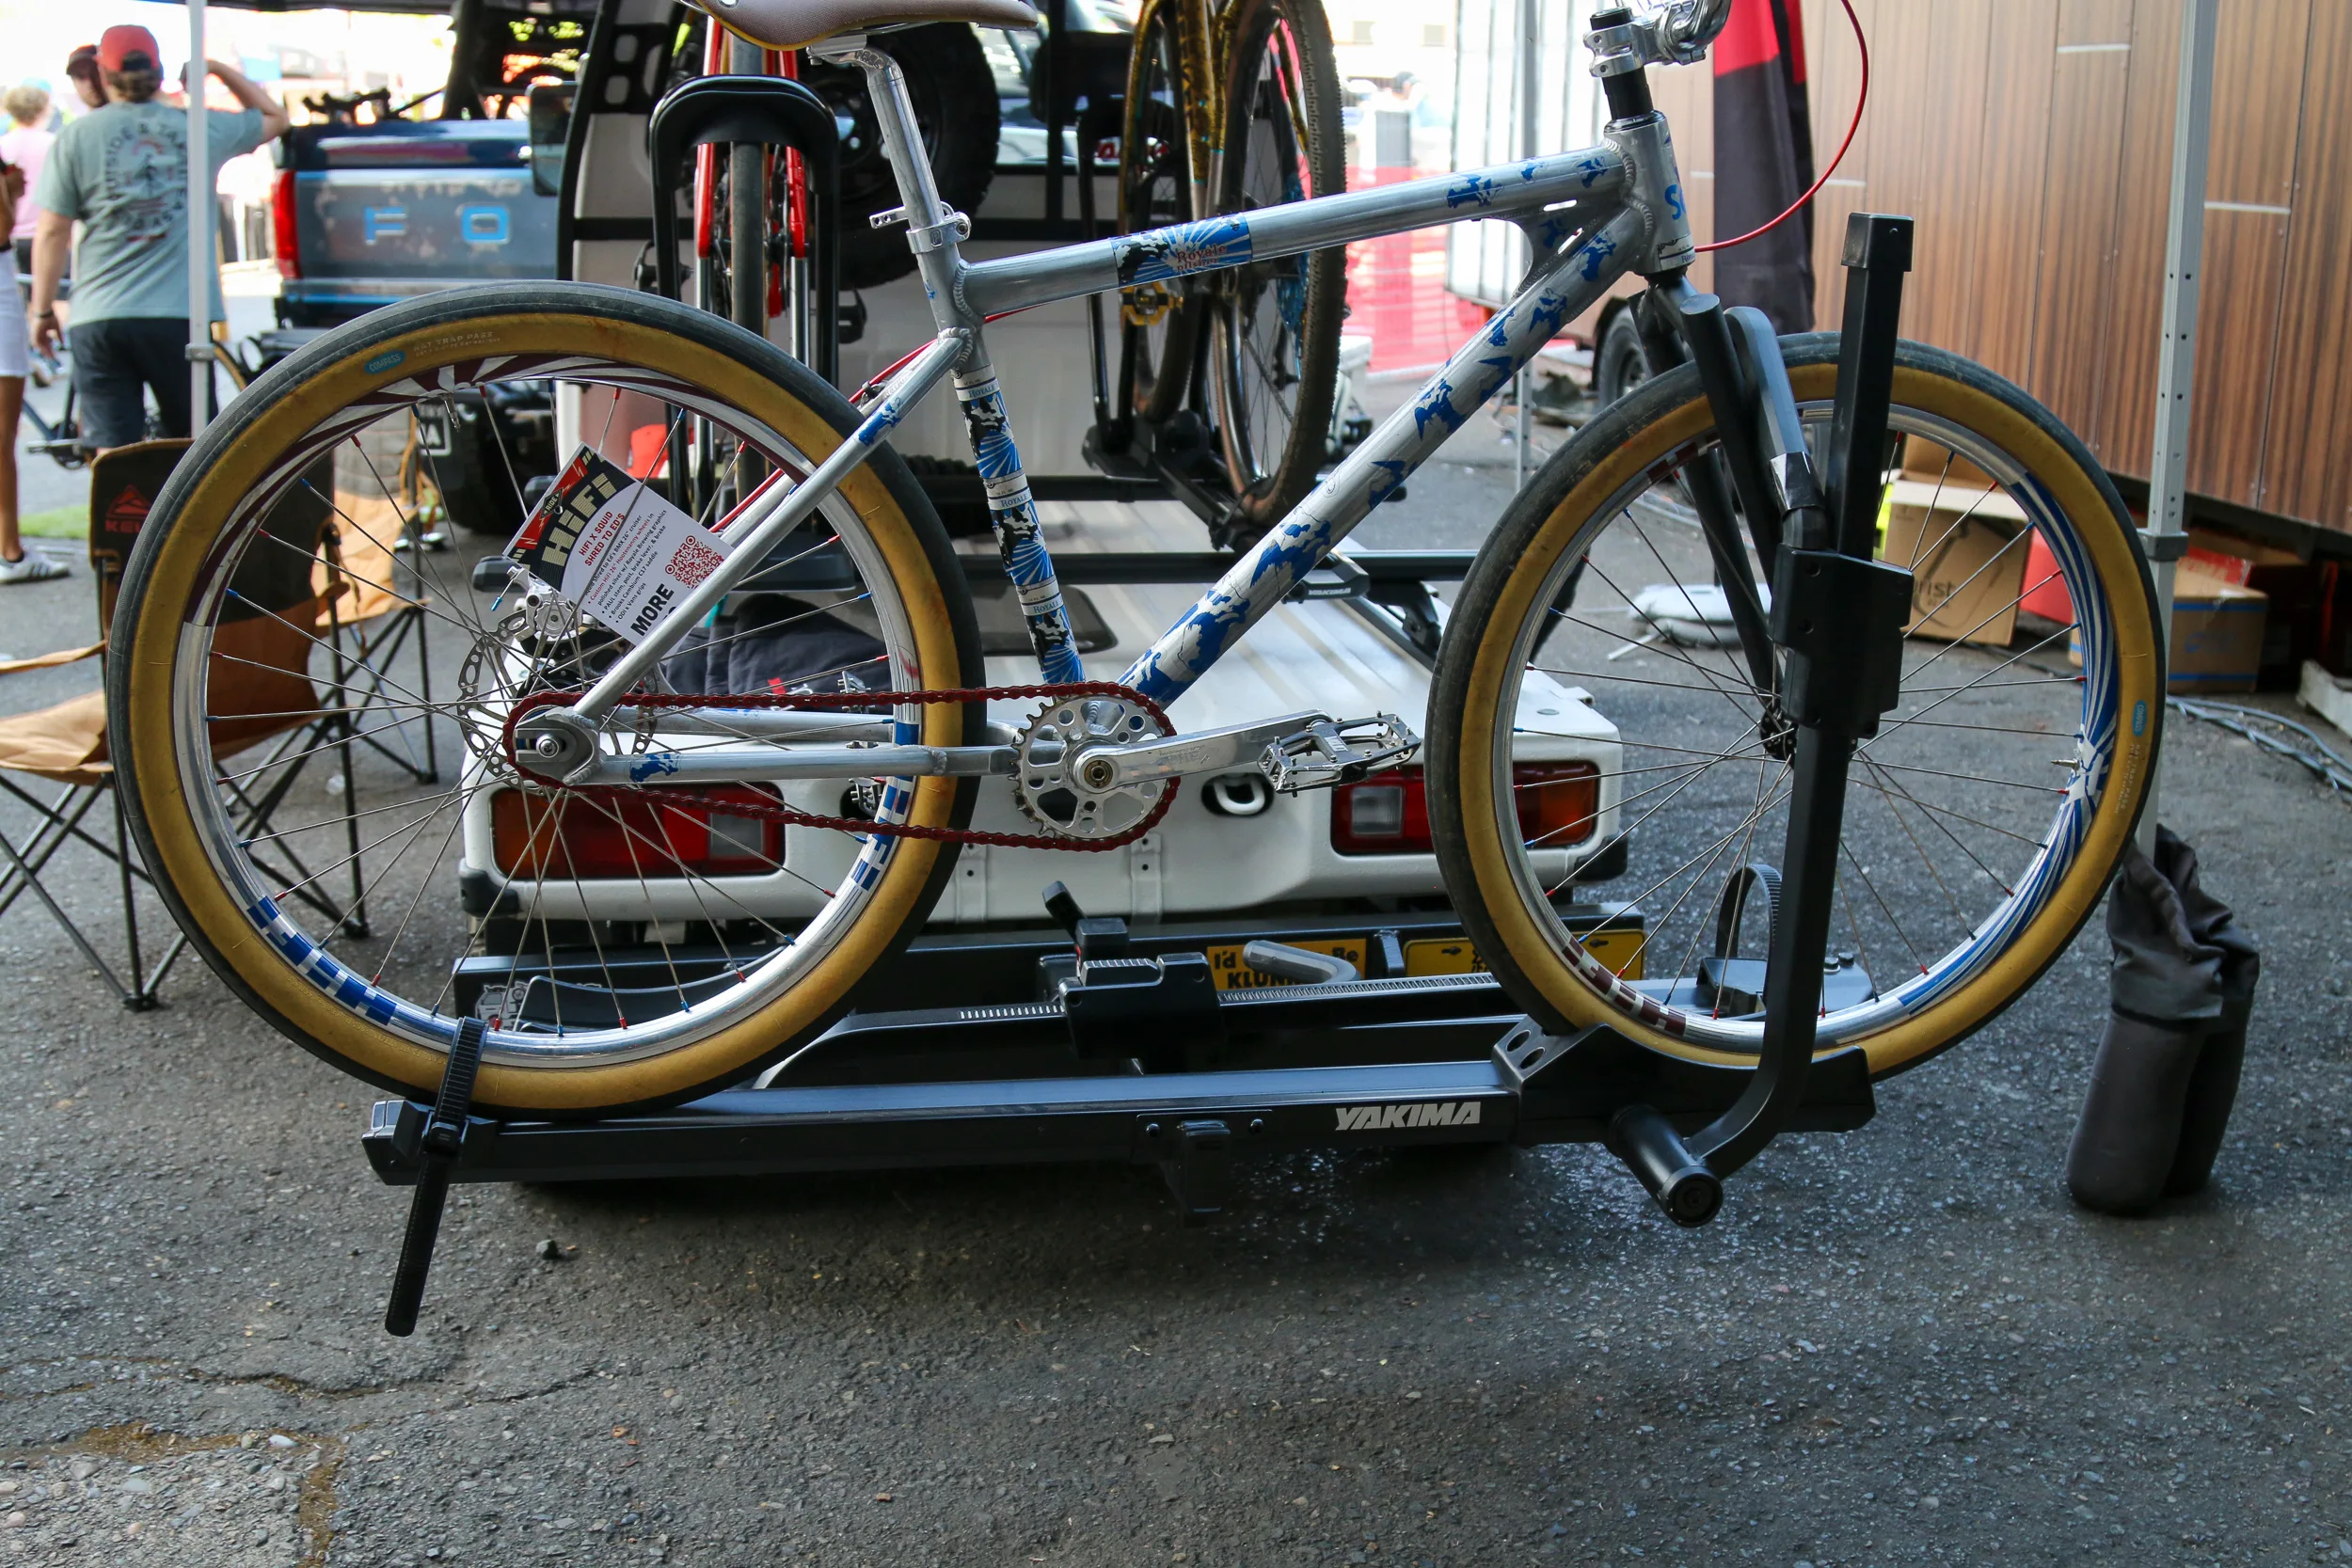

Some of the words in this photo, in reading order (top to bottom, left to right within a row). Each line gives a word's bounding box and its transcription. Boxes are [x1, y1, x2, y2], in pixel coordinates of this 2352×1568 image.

[1177, 244, 1228, 263] Royale
[369, 353, 402, 372] COMPASS
[968, 384, 996, 398] ROYALE
[545, 496, 558, 511] RIDE
[1000, 494, 1028, 508] ROYALE
[578, 540, 593, 556] HIFI
[589, 532, 597, 541] X
[594, 511, 612, 533] SQUID
[584, 541, 605, 566] SHRED
[601, 530, 612, 541] TO
[609, 513, 627, 531] ED'S
[613, 540, 625, 552] BMX
[628, 515, 642, 531] cruiser
[590, 582, 605, 600] Custom
[615, 534, 639, 564] Hootenanny
[636, 518, 650, 535] wheels
[597, 584, 613, 606] polished
[612, 572, 622, 585] silver
[625, 548, 639, 564] Royale
[636, 529, 654, 549] Brewing
[651, 510, 667, 531] graphics
[603, 596, 615, 610] PAUL
[630, 557, 643, 572] brake
[653, 525, 666, 539] brake
[610, 598, 625, 615] Brooks
[622, 576, 641, 598] Cambium
[638, 565, 646, 577] C17
[645, 550, 658, 567] saddle
[627, 594, 638, 606] Vans
[636, 582, 646, 595] grips
[629, 583, 675, 636] MORE
[1032, 600, 1059, 613] ROYALE
[2134, 704, 2145, 733] COMPASS
[1215, 949, 1236, 970] I'd
[1335, 1101, 1482, 1131] YAKIMA
